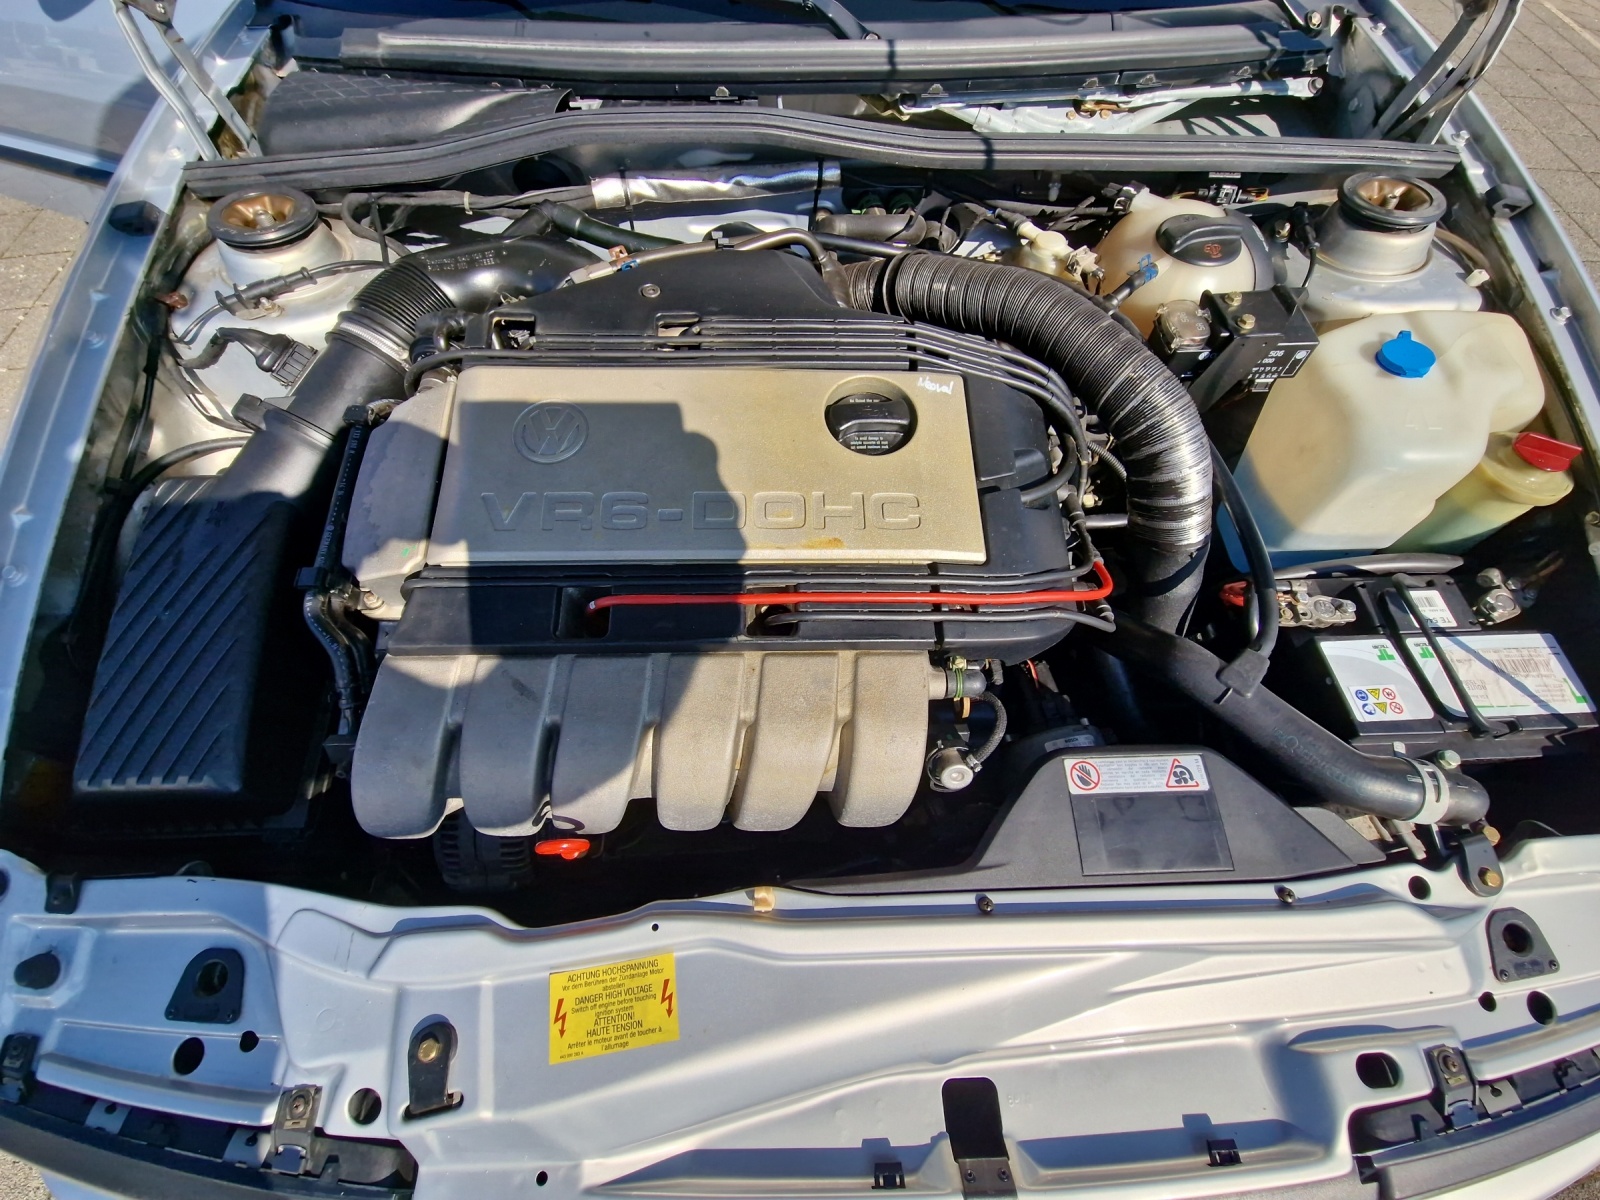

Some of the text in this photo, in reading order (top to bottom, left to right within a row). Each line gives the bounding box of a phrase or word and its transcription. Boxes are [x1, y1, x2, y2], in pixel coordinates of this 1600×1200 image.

[479, 491, 922, 531] VR6-DOHC
[568, 960, 658, 982] ACHTUNG HOCHSPANNUNG
[574, 984, 652, 1006] DANGER HIGH VOLTAGE
[572, 1006, 590, 1014] Switch
[594, 1012, 634, 1028] ATTENTION!
[586, 1020, 642, 1038] HAUTE TENSION
